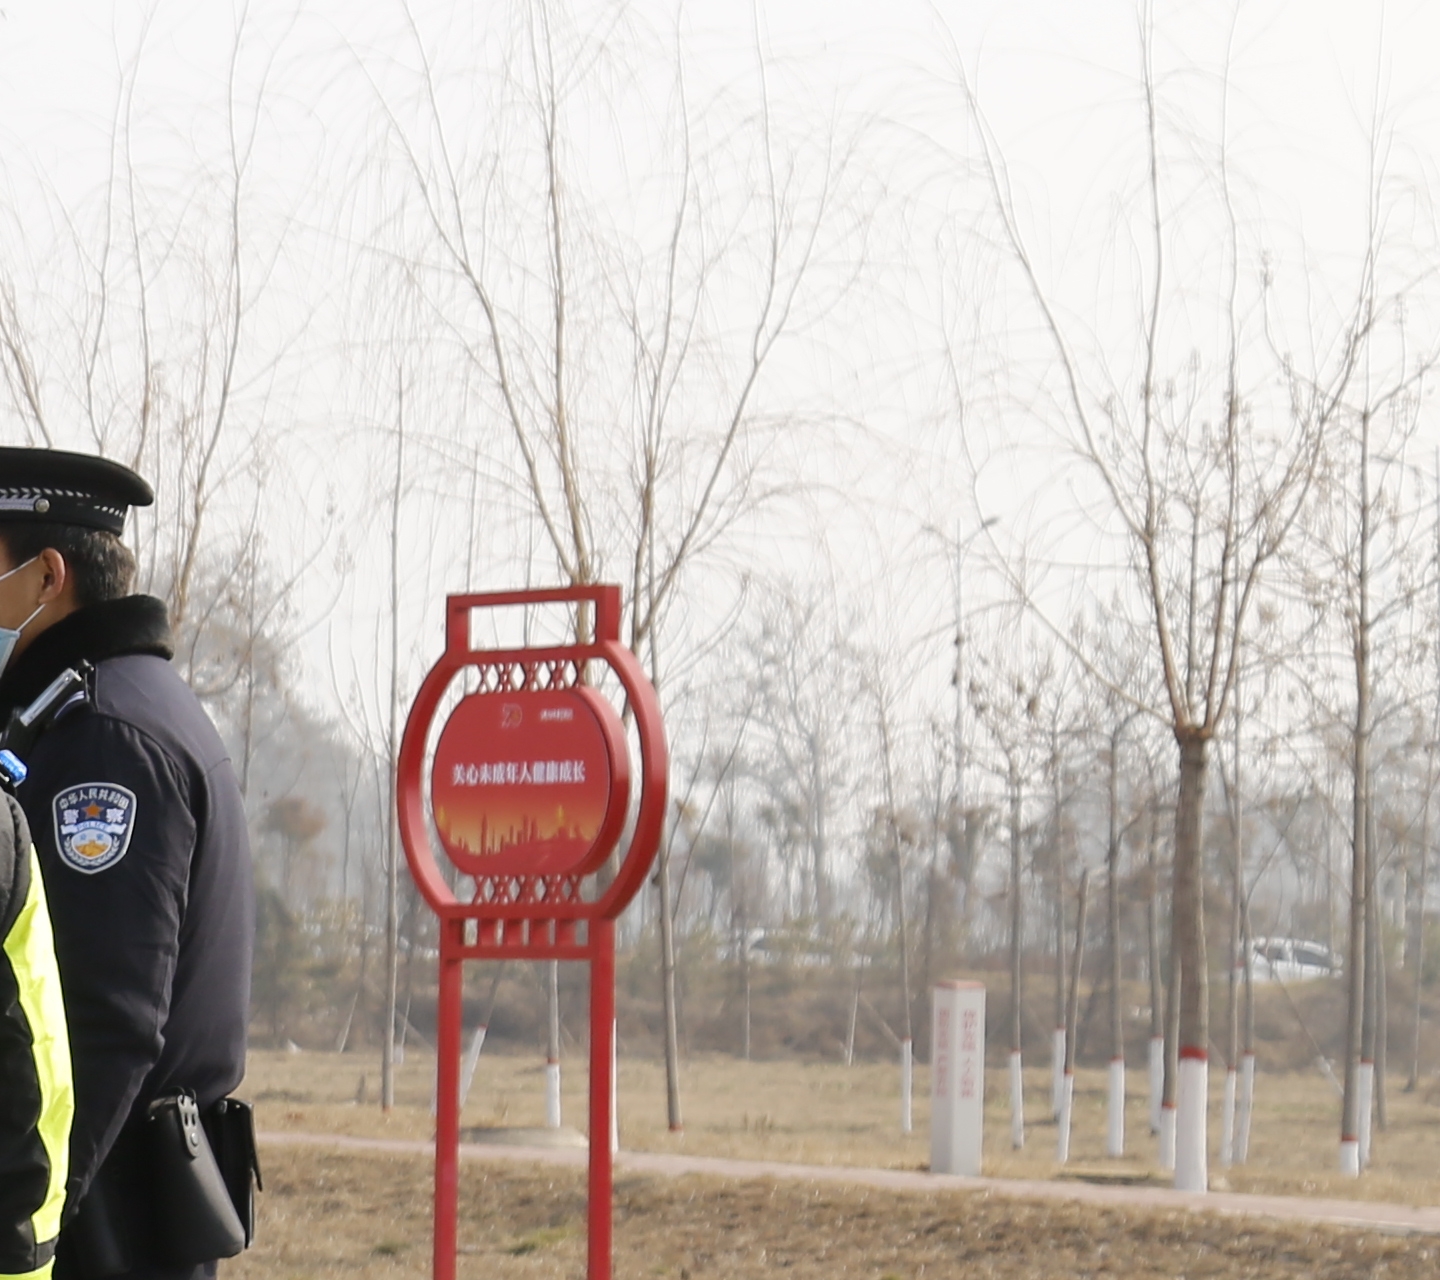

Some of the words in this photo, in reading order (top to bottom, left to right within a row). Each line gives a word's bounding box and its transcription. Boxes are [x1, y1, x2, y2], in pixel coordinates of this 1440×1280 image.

[453, 760, 586, 786] 关心未成年人健康成长
[59, 788, 130, 810] 中华人民共和国
